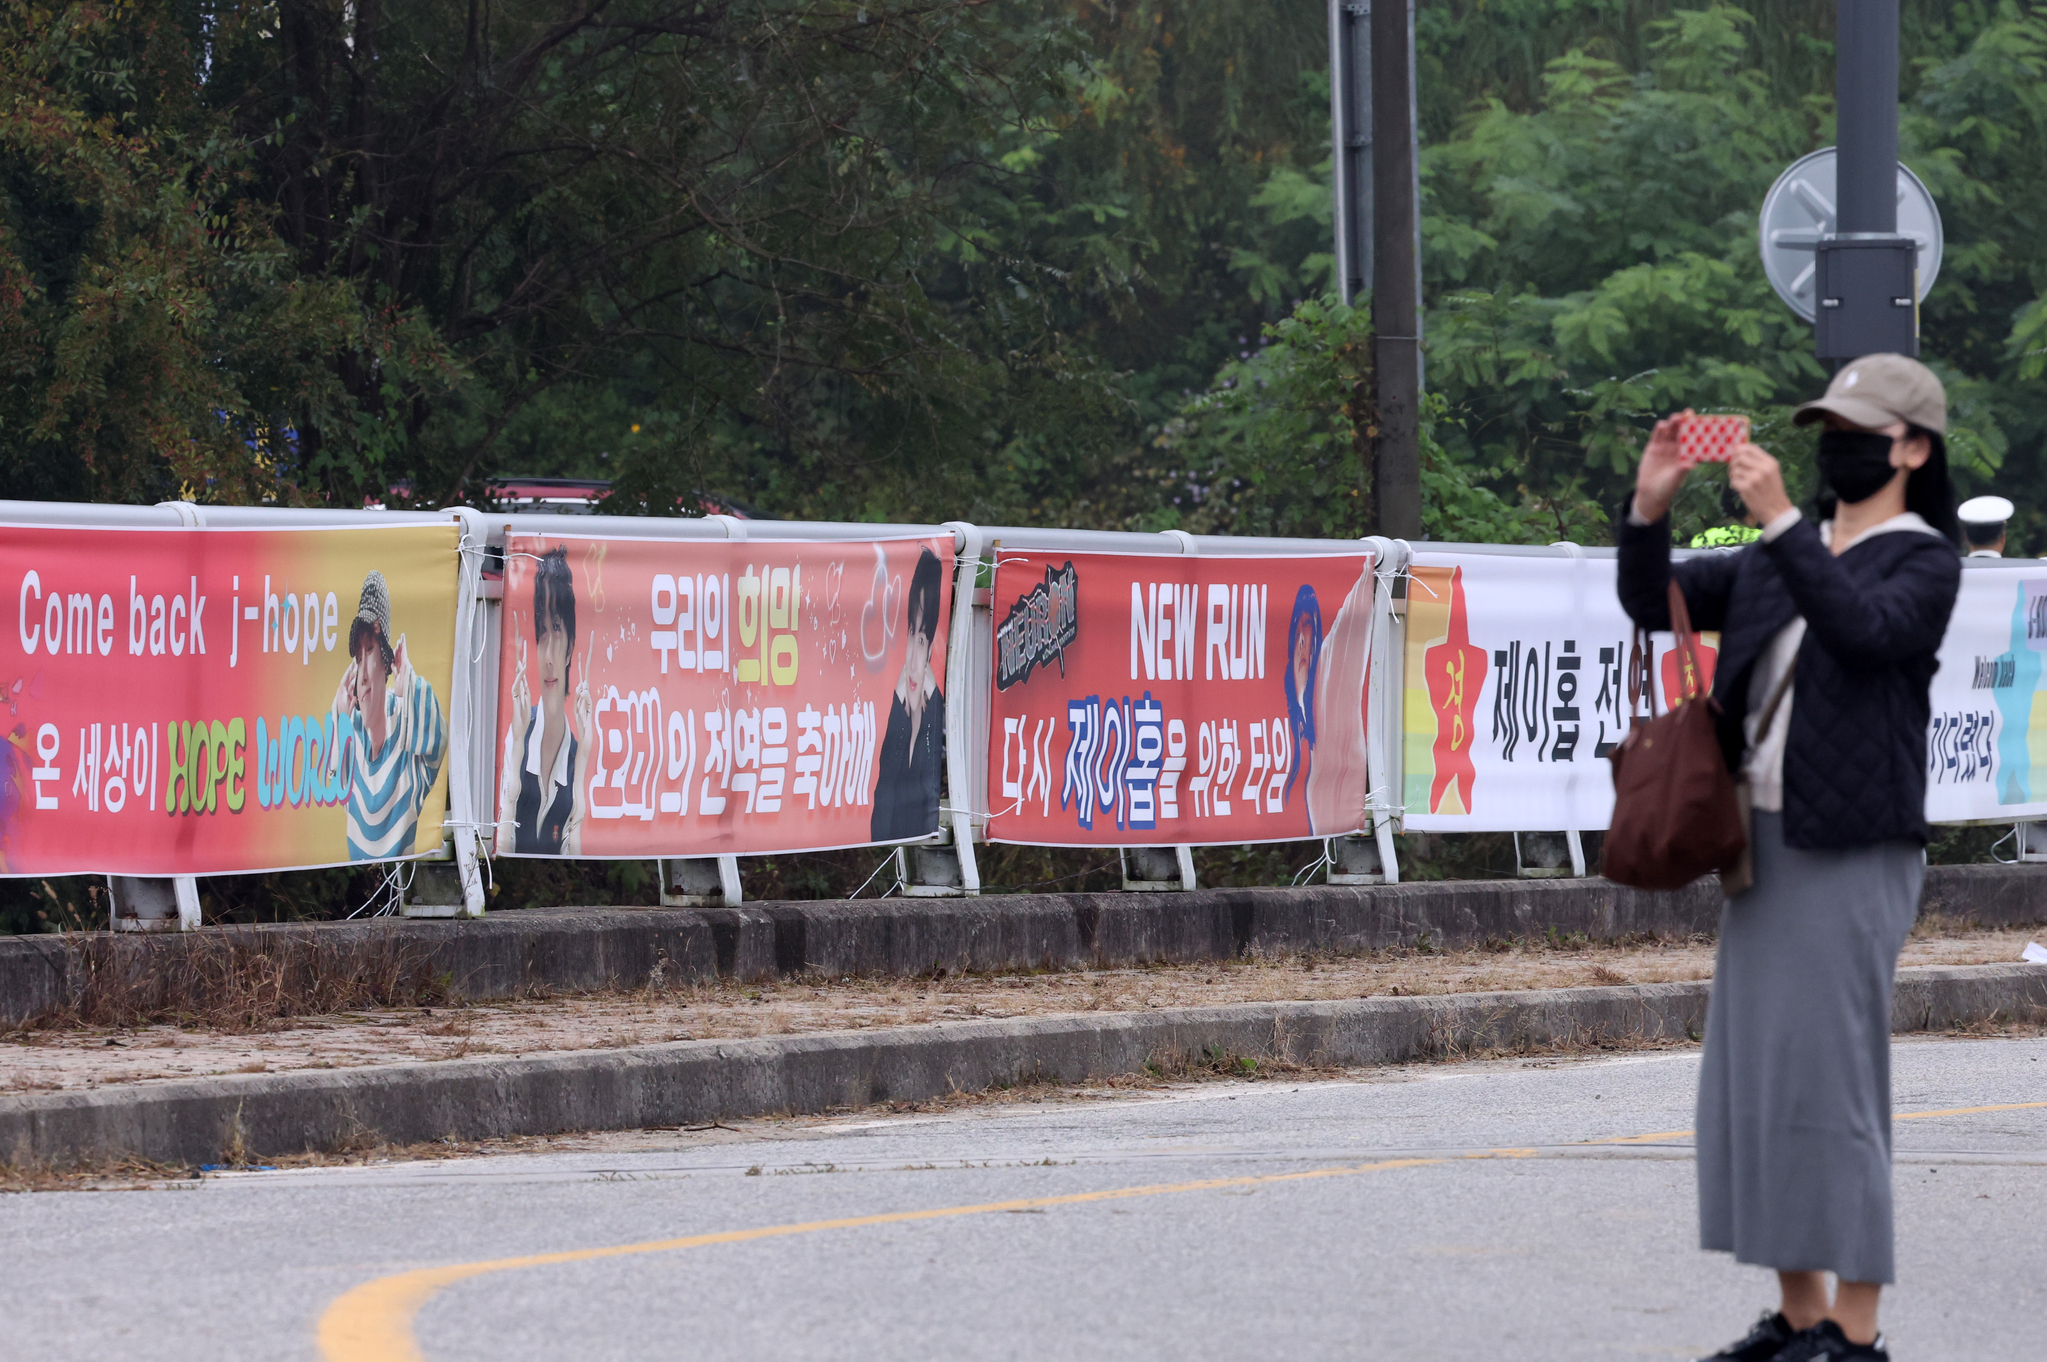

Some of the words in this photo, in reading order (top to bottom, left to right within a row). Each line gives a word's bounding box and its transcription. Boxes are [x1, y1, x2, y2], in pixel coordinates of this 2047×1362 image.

[19, 570, 114, 655] Come
[129, 575, 206, 657] back
[230, 575, 339, 668] j-hope
[651, 572, 729, 674] 우리의
[737, 563, 800, 686] 희망
[1131, 582, 1198, 680] NEW
[1206, 584, 1267, 680] RUN
[590, 685, 695, 821] 호비의
[700, 706, 788, 816] 전역을
[794, 701, 876, 809] 축하해
[1492, 640, 1582, 762] 제이홉
[32, 722, 61, 810] 온
[72, 722, 158, 813] 세상이
[166, 717, 246, 816] HOPE
[256, 712, 355, 811] WORLD
[1002, 715, 1055, 817] 다시
[1062, 694, 1187, 827] 제이홉을
[1189, 718, 1241, 817] 위한
[1242, 717, 1293, 815] 타임
